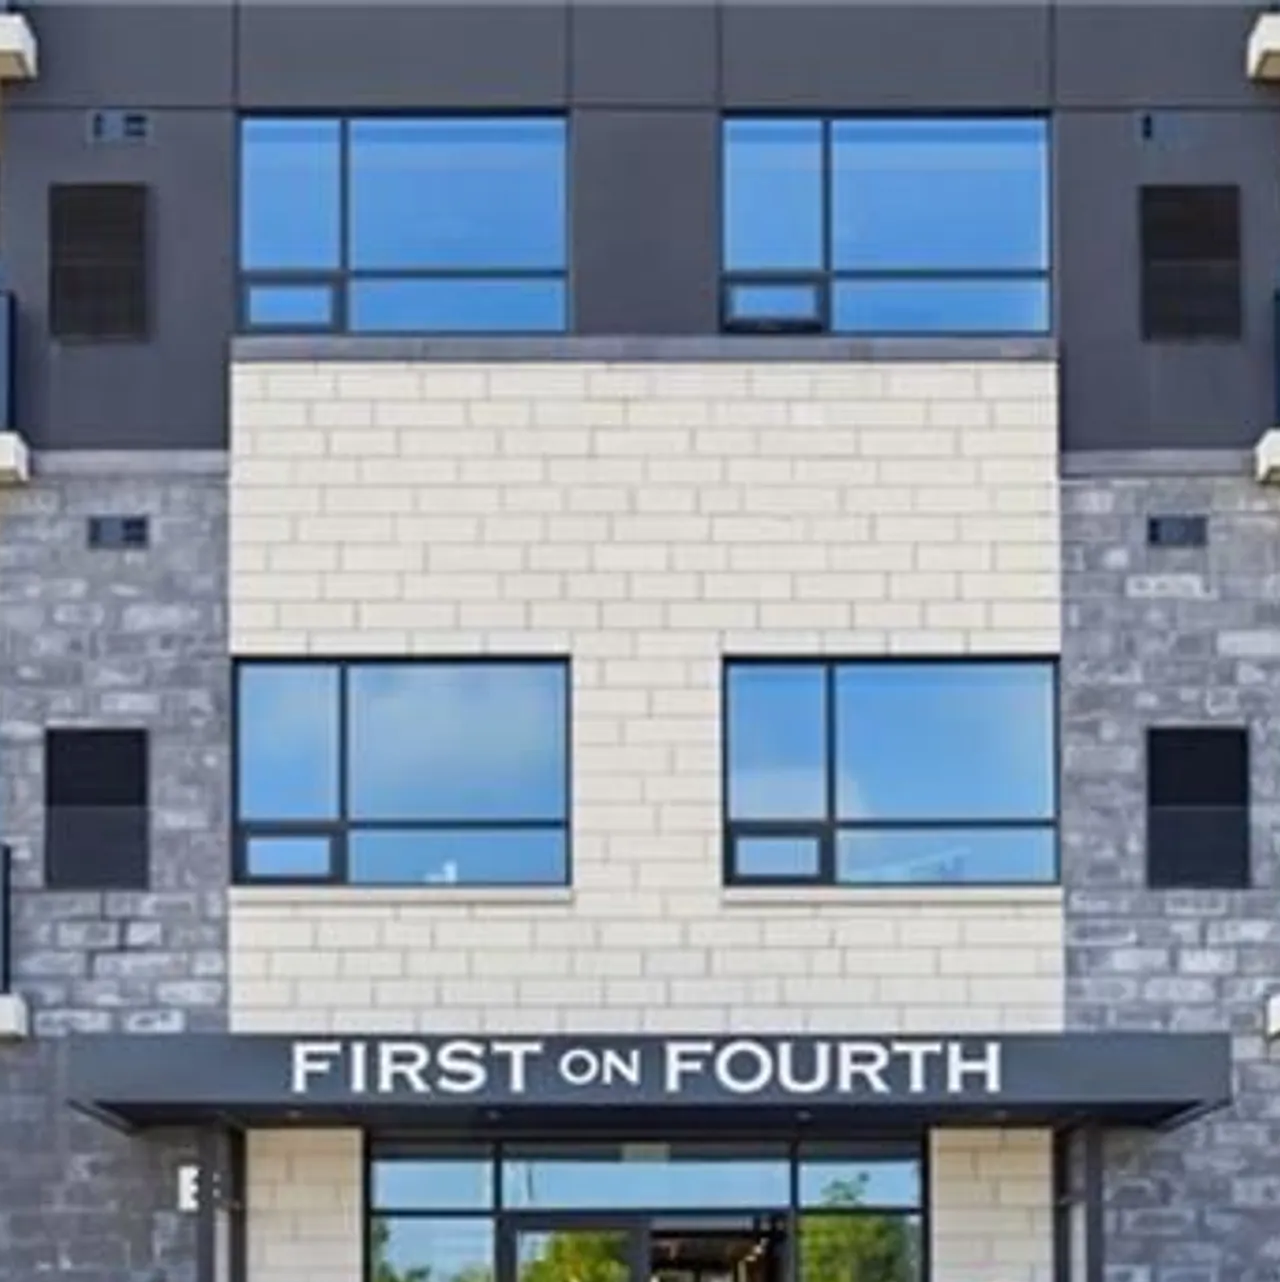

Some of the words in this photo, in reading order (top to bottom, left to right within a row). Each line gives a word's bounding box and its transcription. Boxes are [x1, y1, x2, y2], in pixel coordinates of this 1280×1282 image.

[291, 1040, 544, 1094] FIRST
[558, 1048, 641, 1085] ON
[664, 1040, 1002, 1094] FOURTH
